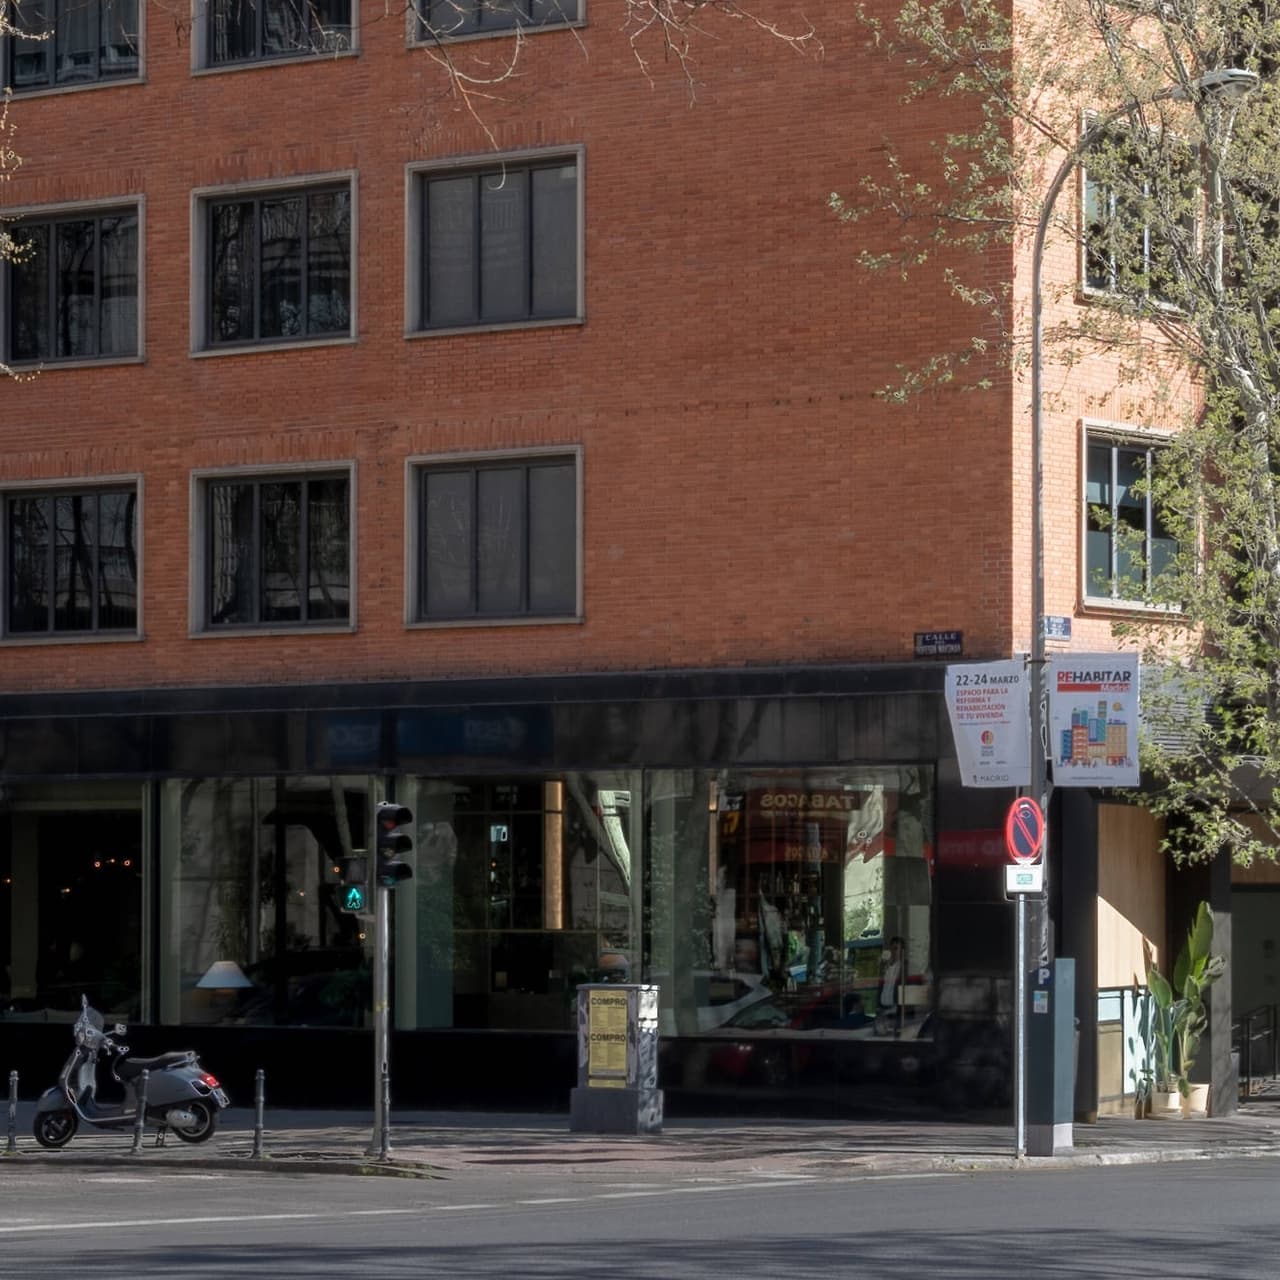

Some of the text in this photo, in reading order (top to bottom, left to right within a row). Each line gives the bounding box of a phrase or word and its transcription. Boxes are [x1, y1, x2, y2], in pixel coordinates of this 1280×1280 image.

[956, 674, 1019, 686] 22-24 MARZO
[1057, 671, 1132, 682] REHABITAR
[1038, 969, 1050, 985] P
[591, 997, 626, 1005] COMPRO
